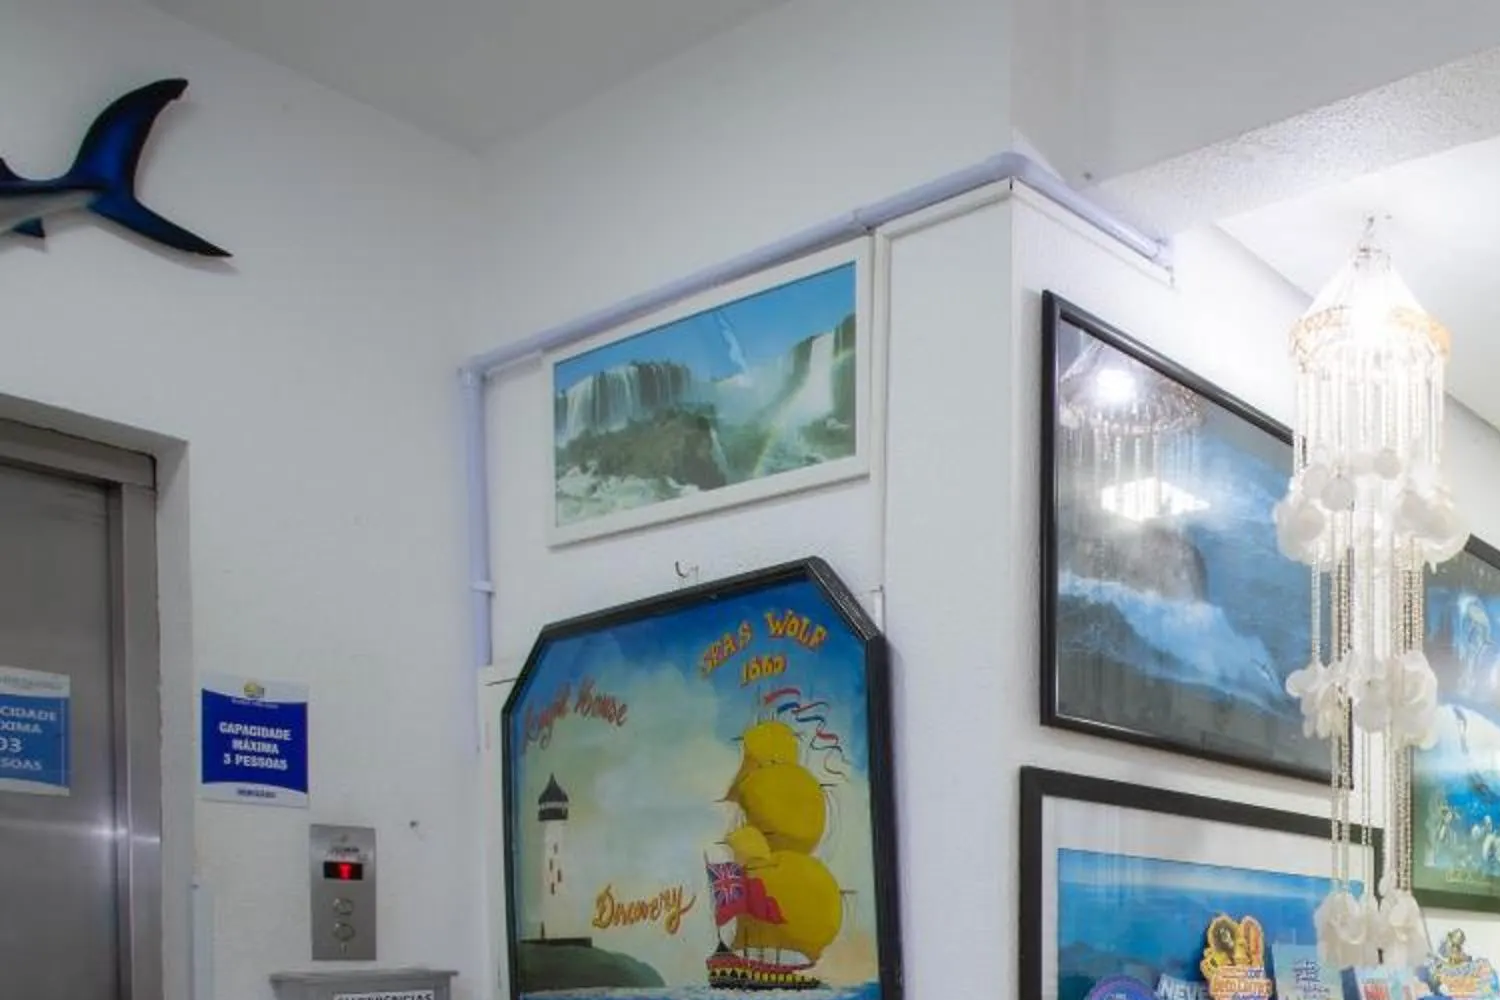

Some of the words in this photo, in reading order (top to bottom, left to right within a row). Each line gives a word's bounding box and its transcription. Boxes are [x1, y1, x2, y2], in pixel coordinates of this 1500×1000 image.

[219, 721, 292, 741] CAPACIDADE
[232, 738, 279, 754] MÁXIMA
[235, 754, 288, 771] PESSOAS
